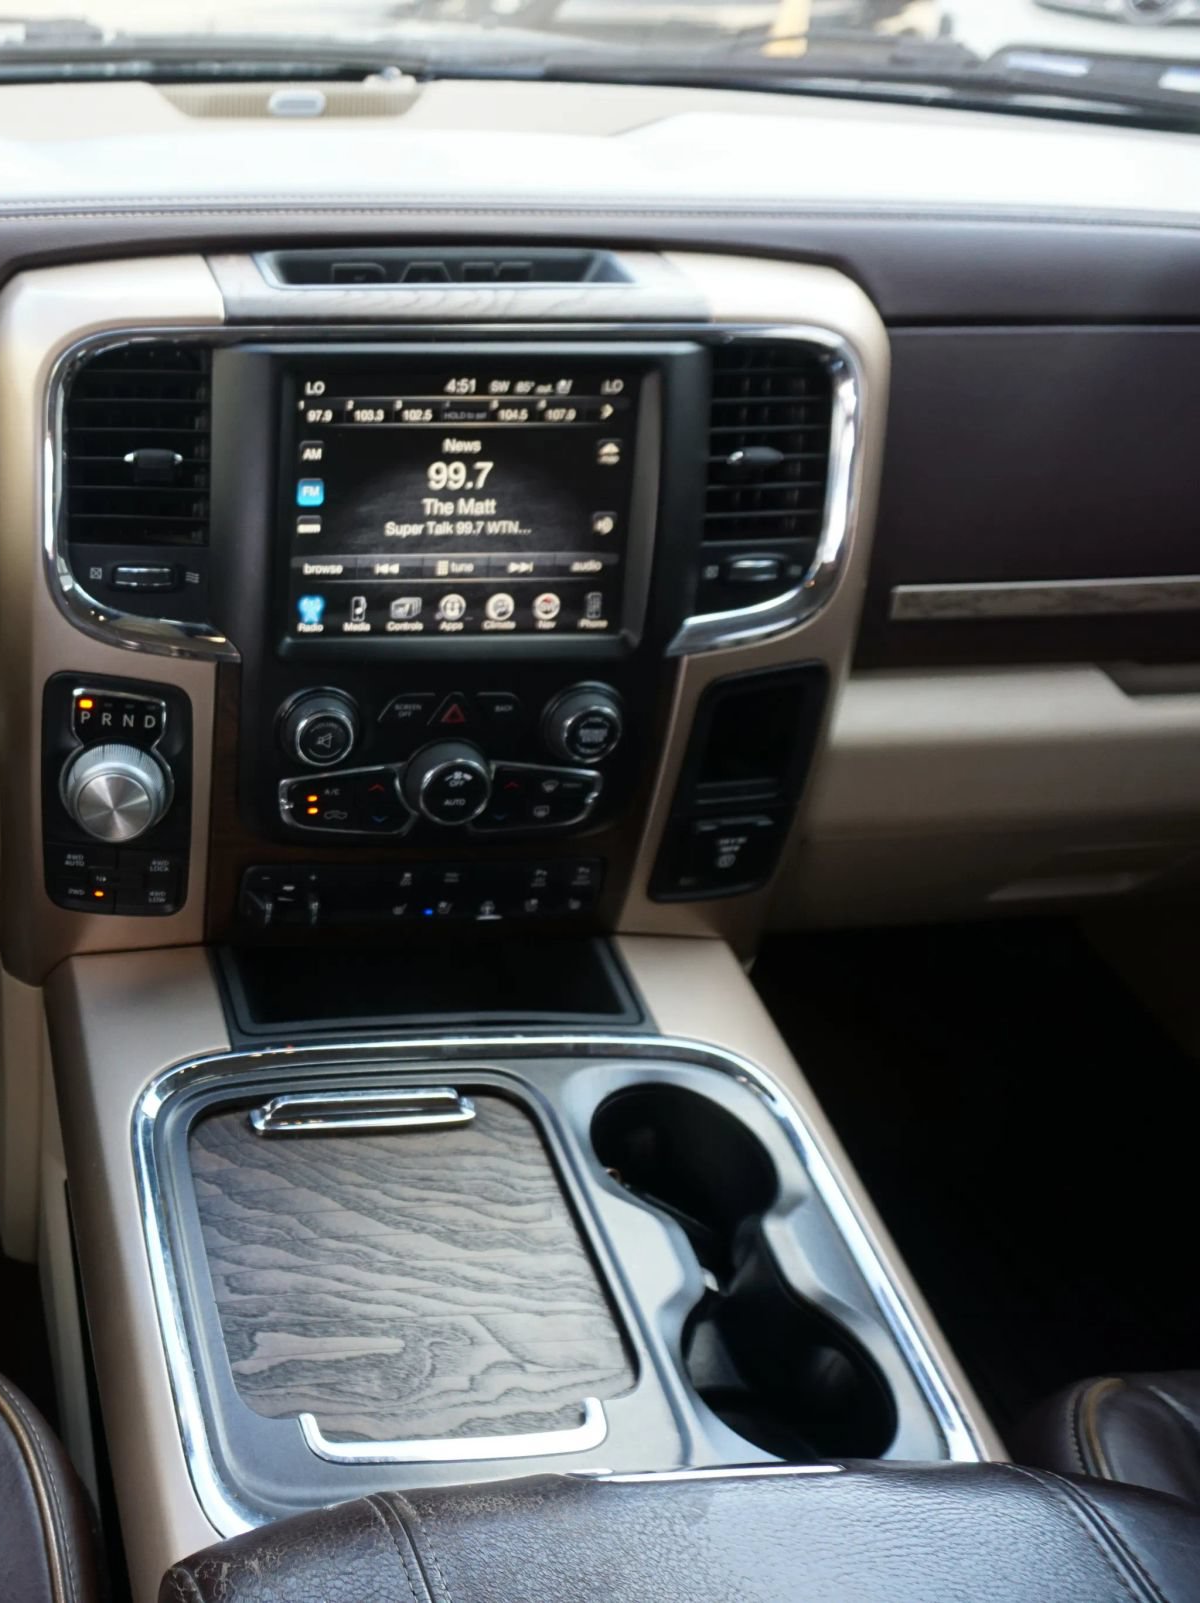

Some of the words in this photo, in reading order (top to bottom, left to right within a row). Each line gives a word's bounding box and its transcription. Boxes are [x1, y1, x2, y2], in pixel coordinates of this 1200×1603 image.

[305, 381, 326, 395] LO
[445, 379, 477, 393] 4:51
[602, 380, 624, 394] LO
[307, 409, 333, 422] 97.9
[354, 409, 384, 422] 103.3
[402, 409, 433, 422] 102.5
[498, 409, 528, 422] 104.5
[442, 438, 482, 453] News
[303, 448, 322, 461] AM
[427, 461, 494, 491] 99.7
[302, 486, 320, 498] FM
[421, 498, 455, 516] The
[456, 498, 497, 516] Matt
[384, 521, 425, 538] Super
[426, 521, 455, 536] Talk
[455, 521, 484, 536] 99.7
[303, 563, 344, 575] browse
[451, 561, 475, 574] tune
[570, 560, 603, 573] audio
[298, 622, 324, 633] Radio
[343, 621, 371, 633] Media
[387, 620, 424, 632] Controls
[440, 620, 463, 633] Apps
[482, 620, 517, 631] Climate
[577, 618, 609, 630] Phone
[80, 711, 91, 725] P
[101, 712, 112, 726] R
[122, 713, 135, 728] N
[144, 715, 156, 729] D
[444, 798, 466, 806] AUTO
